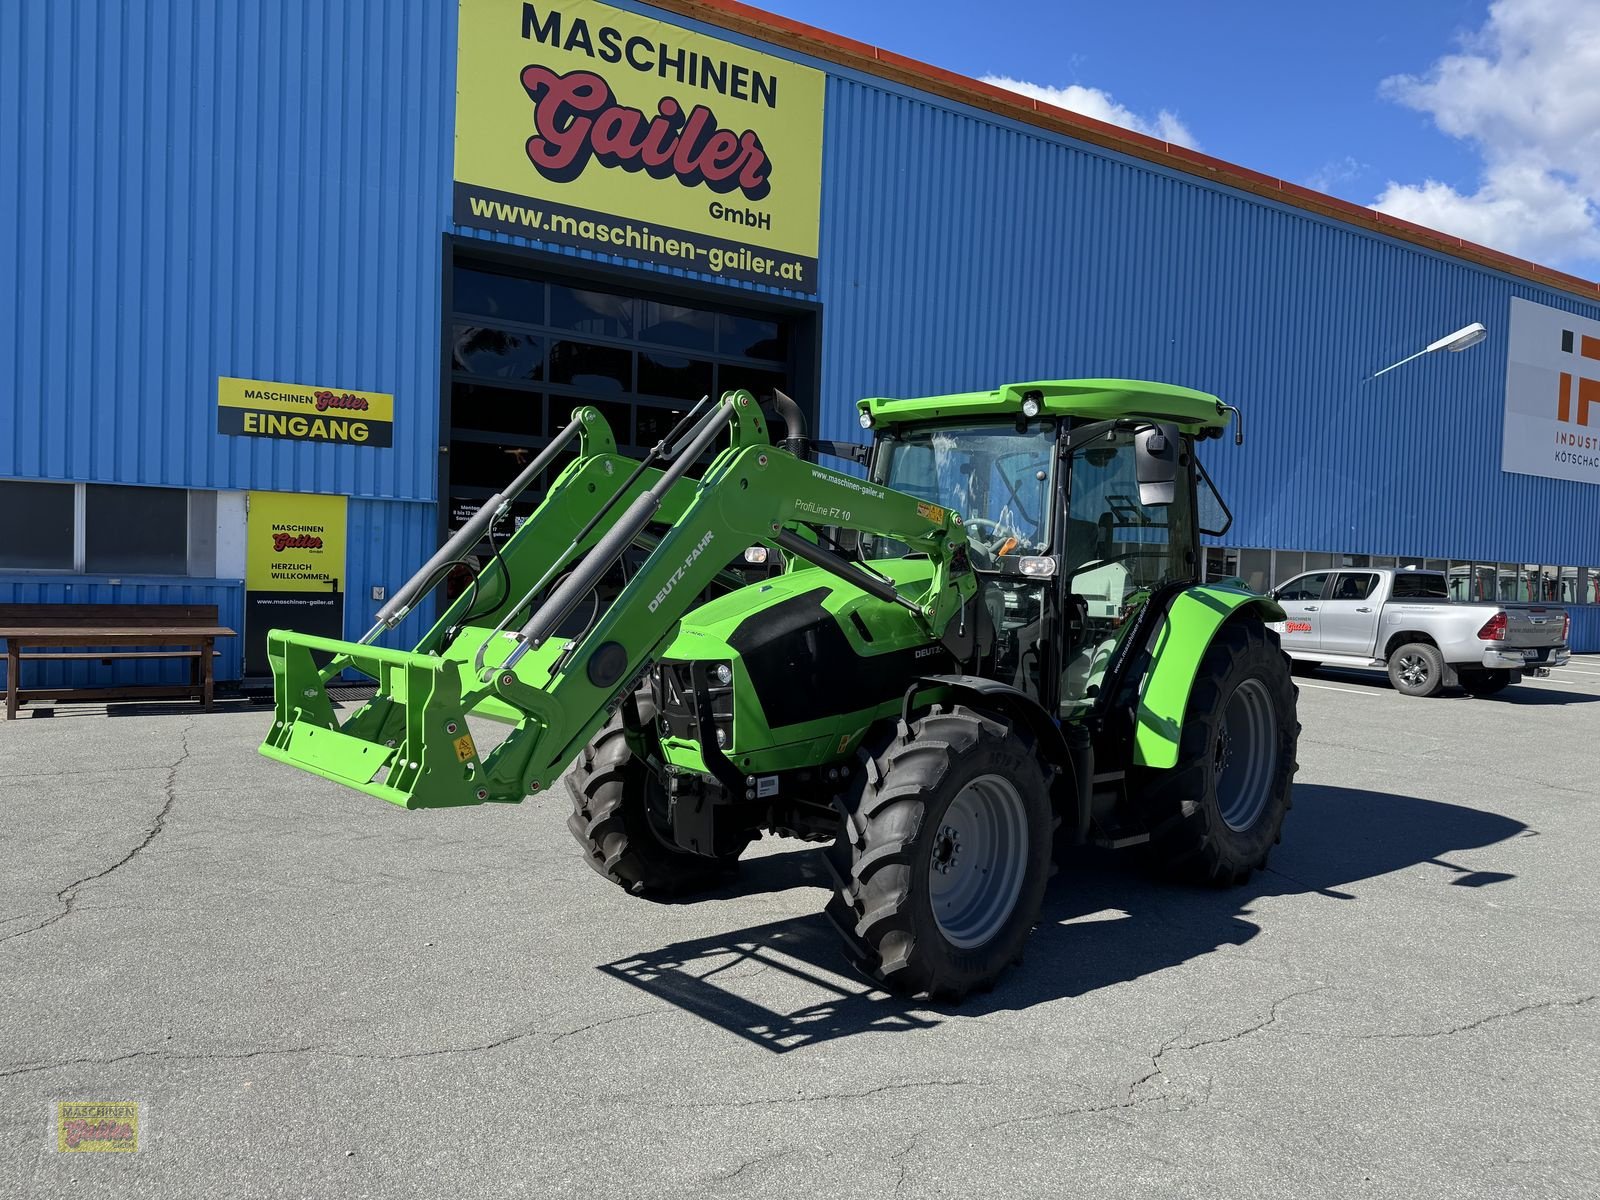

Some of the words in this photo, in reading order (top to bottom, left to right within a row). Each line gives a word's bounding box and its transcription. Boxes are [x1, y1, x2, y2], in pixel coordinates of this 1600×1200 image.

[521, 2, 777, 109] MASCHINEN
[520, 64, 773, 201] Gailer
[709, 201, 771, 231] GmbH
[469, 197, 803, 281] www.maschinen-gailer.at
[244, 389, 313, 405] MASCHINEN
[314, 391, 369, 412] Gailer
[243, 412, 369, 442] EINGANG
[1555, 431, 1600, 451] INDUST
[811, 469, 885, 499] www.maschinen-gailer.at
[795, 499, 828, 516] ProfiLine
[829, 507, 841, 519] FZ
[842, 510, 851, 521] 10
[272, 524, 324, 533] MASCHINEN
[271, 563, 312, 571] HERZLICH
[271, 572, 330, 580] WILLKOMMEN
[648, 530, 714, 613] DEUTZ-FAHR
[915, 646, 945, 659] DEUTZ-
